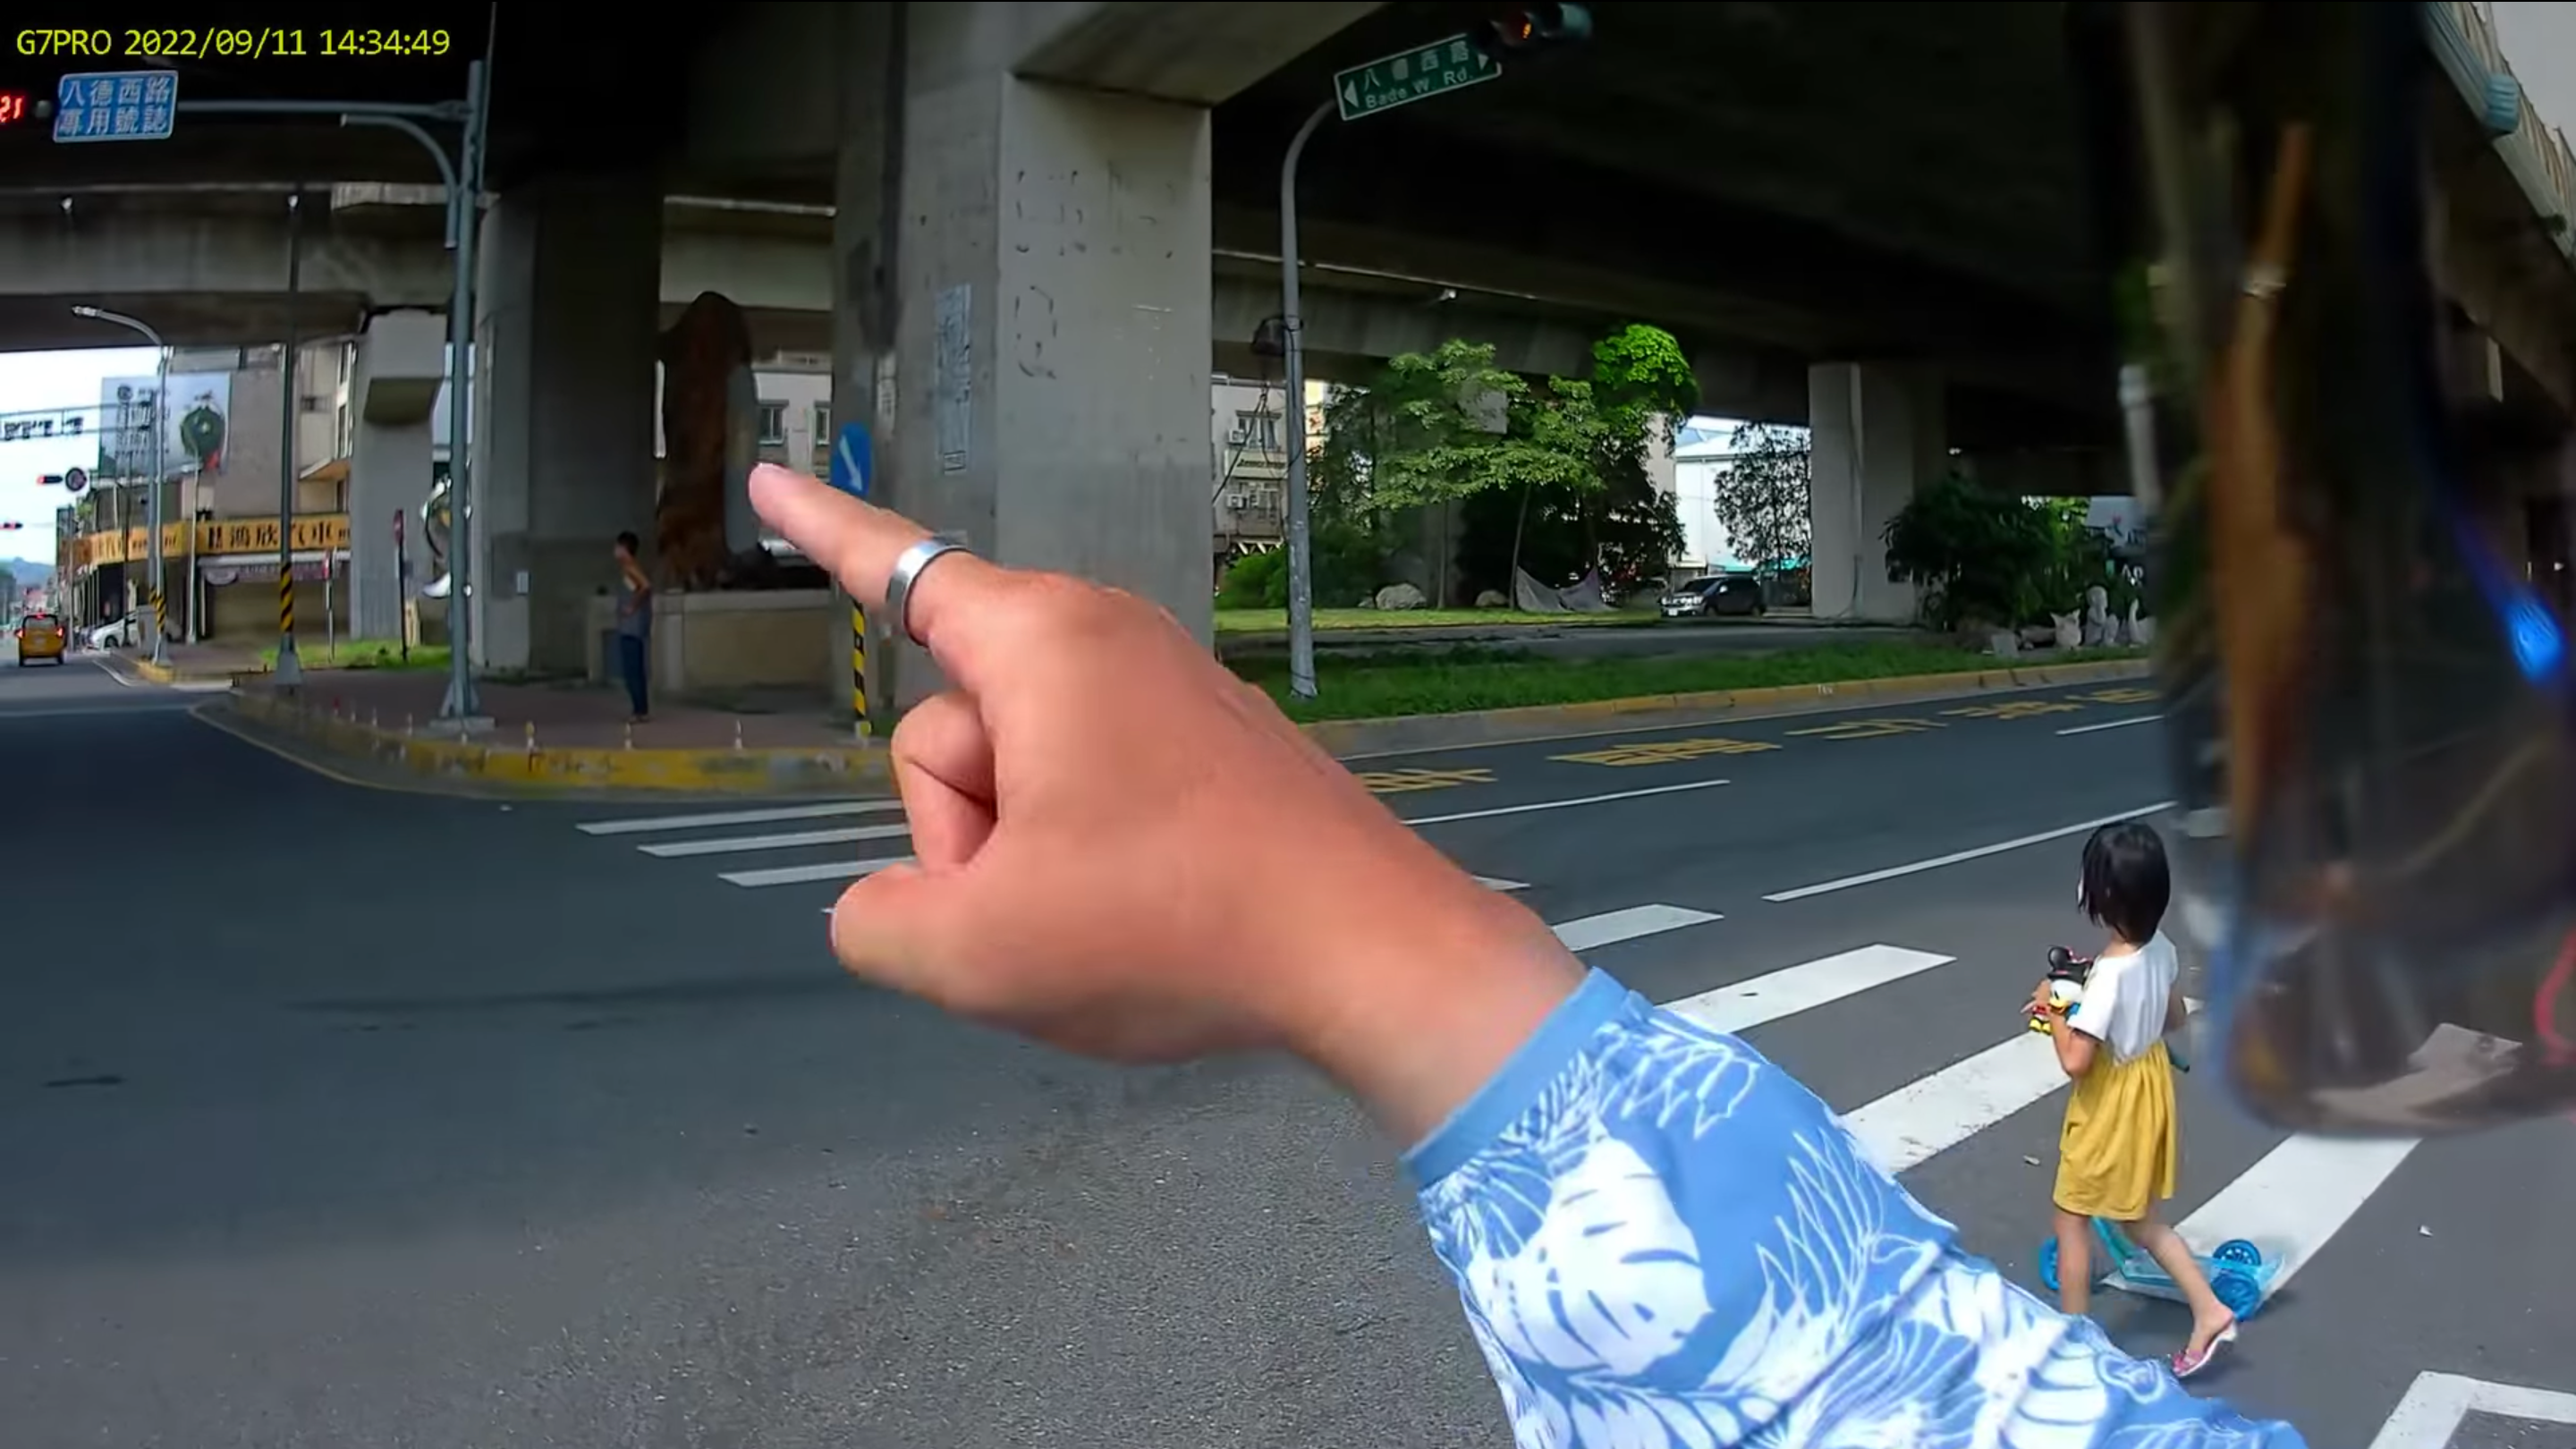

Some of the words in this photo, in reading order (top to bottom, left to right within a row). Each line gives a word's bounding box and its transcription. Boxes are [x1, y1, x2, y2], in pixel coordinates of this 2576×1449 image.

[62, 76, 171, 106] 八德西路
[1365, 85, 1408, 109] Bade
[58, 106, 168, 136] 專用號誌
